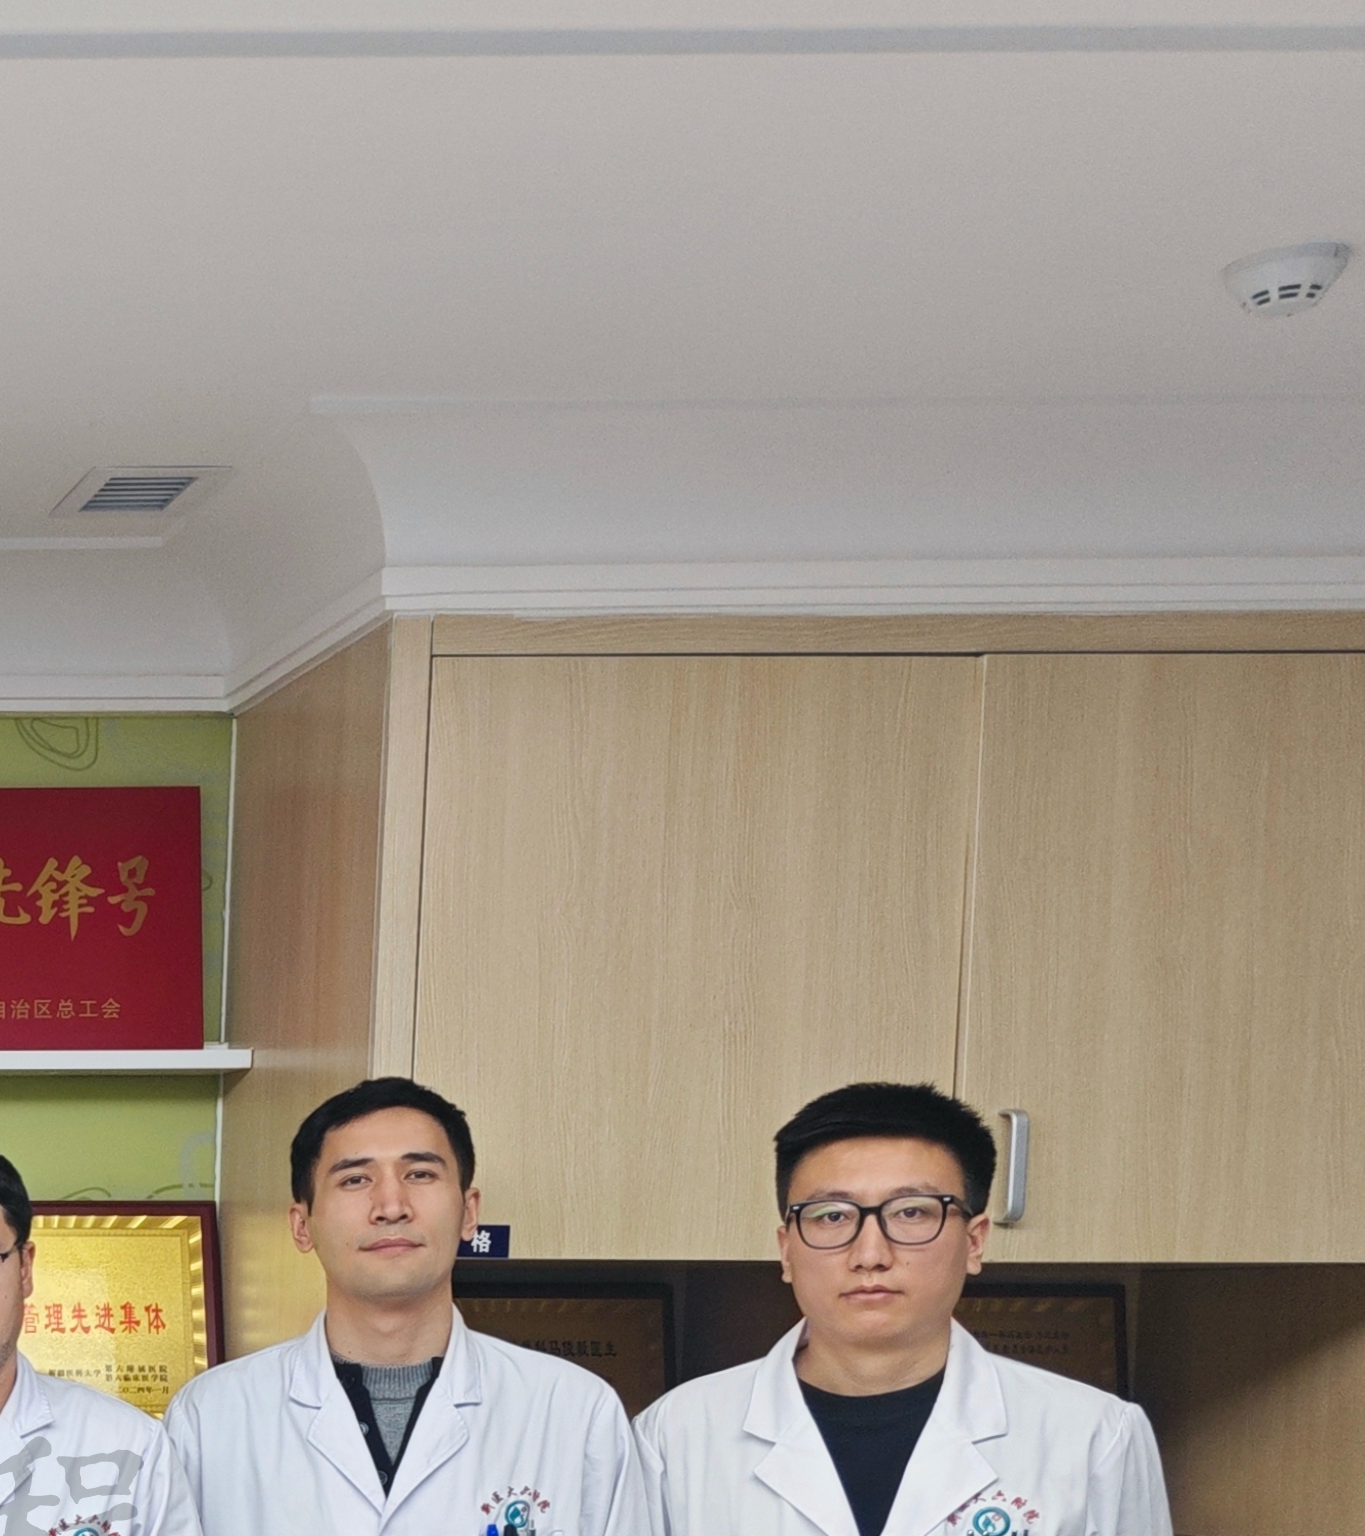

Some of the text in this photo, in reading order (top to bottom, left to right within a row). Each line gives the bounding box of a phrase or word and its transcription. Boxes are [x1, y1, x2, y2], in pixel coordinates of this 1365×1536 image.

[23, 1301, 167, 1335] 管理先进集体
